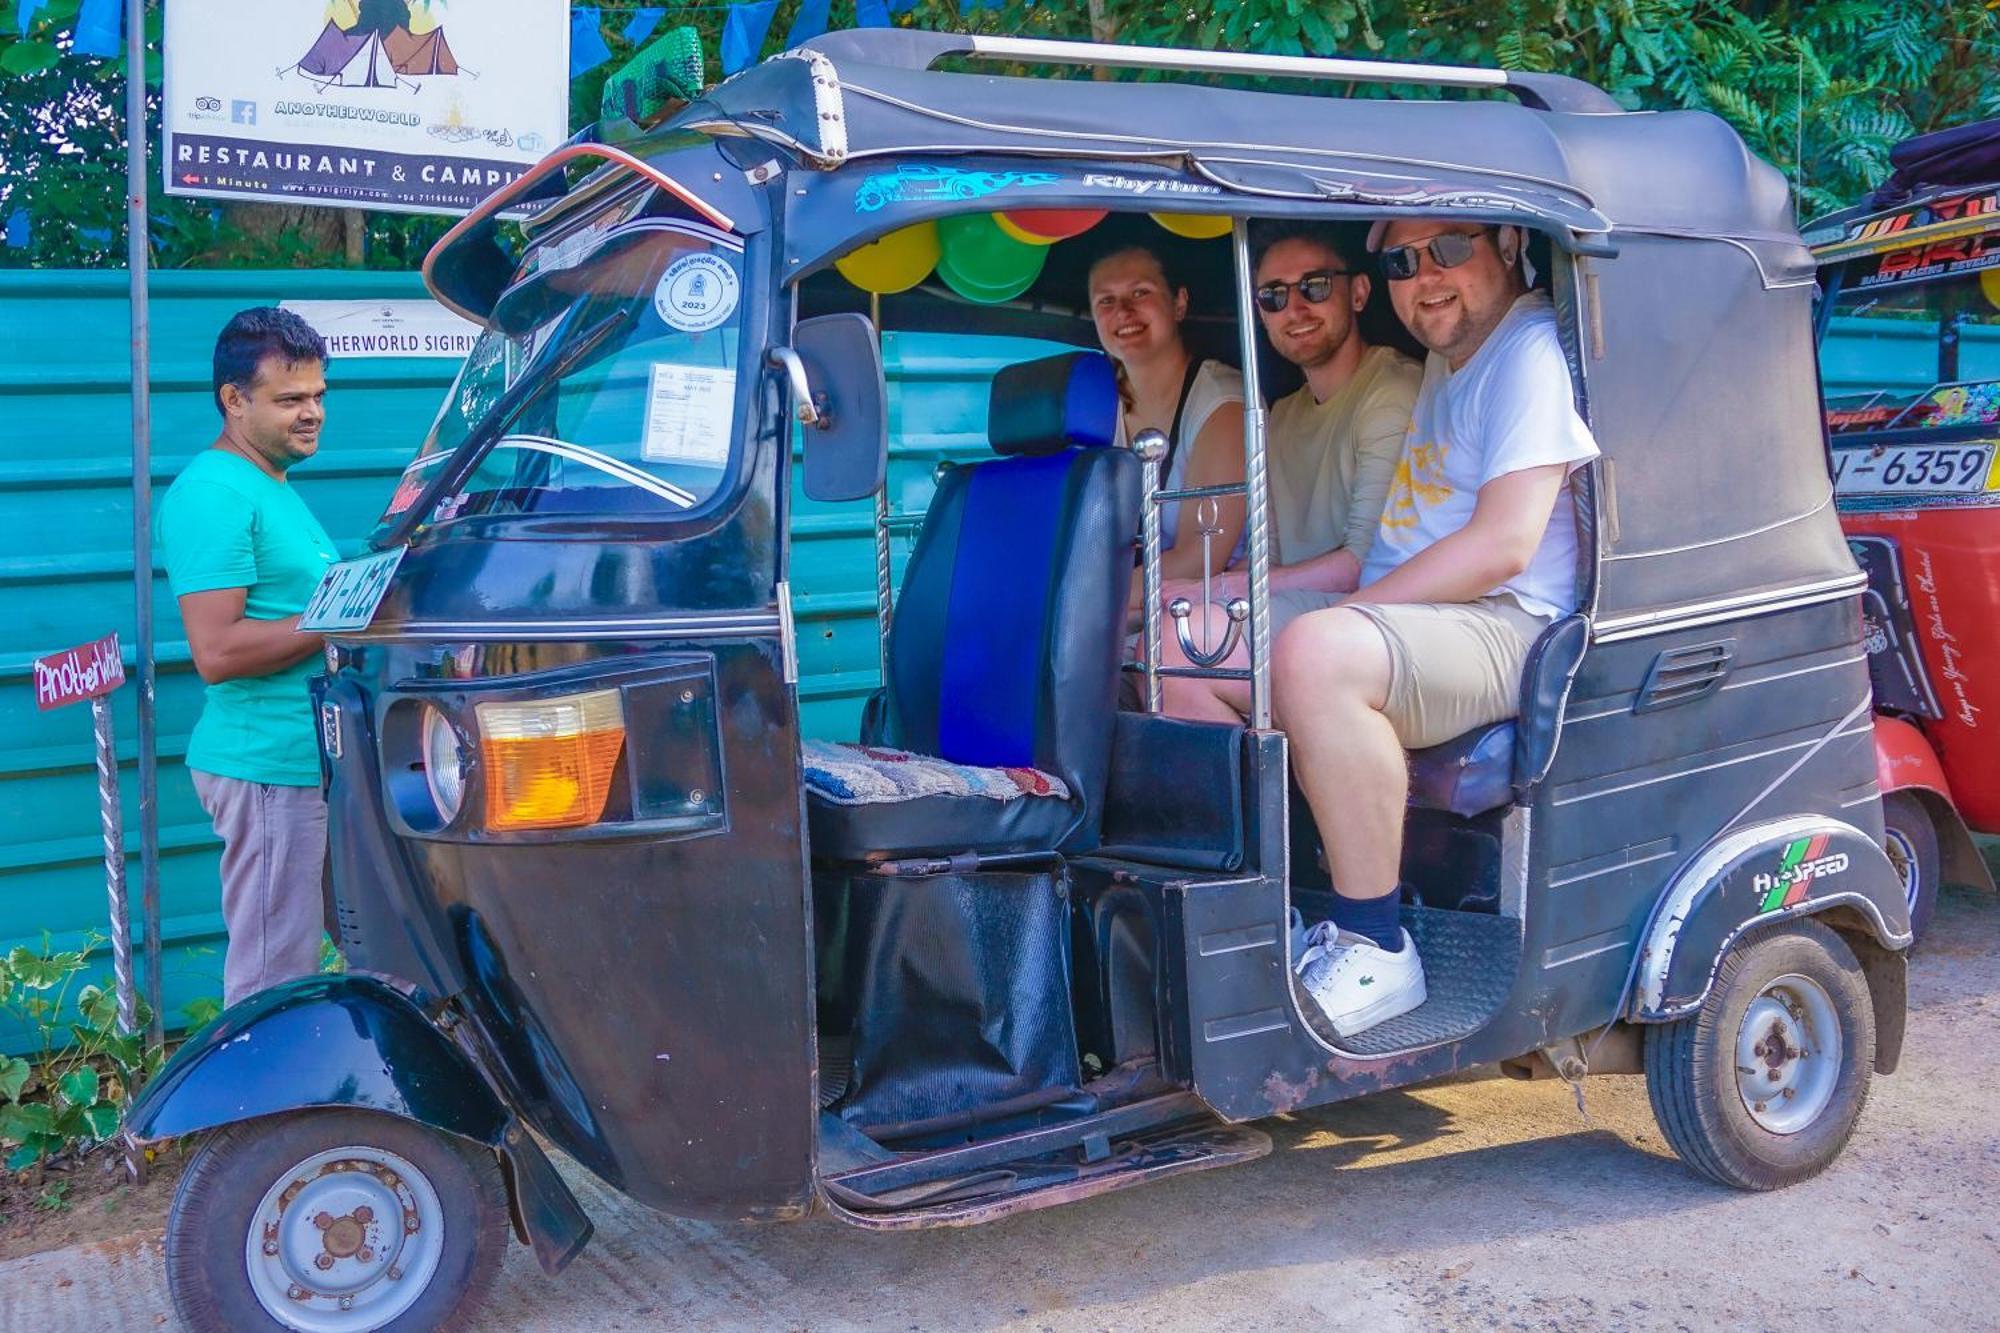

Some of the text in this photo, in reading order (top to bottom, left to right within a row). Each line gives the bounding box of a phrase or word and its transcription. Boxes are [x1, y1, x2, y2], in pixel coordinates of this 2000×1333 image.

[274, 100, 421, 127] ANOTHERWORLD
[178, 144, 376, 177] RESTAURANT
[391, 164, 406, 182] &
[203, 176, 209, 184] 1
[216, 176, 268, 190] Minute
[1861, 271, 1895, 286] BAJAJ
[1900, 263, 1945, 283] RACING
[682, 300, 707, 310] 2023
